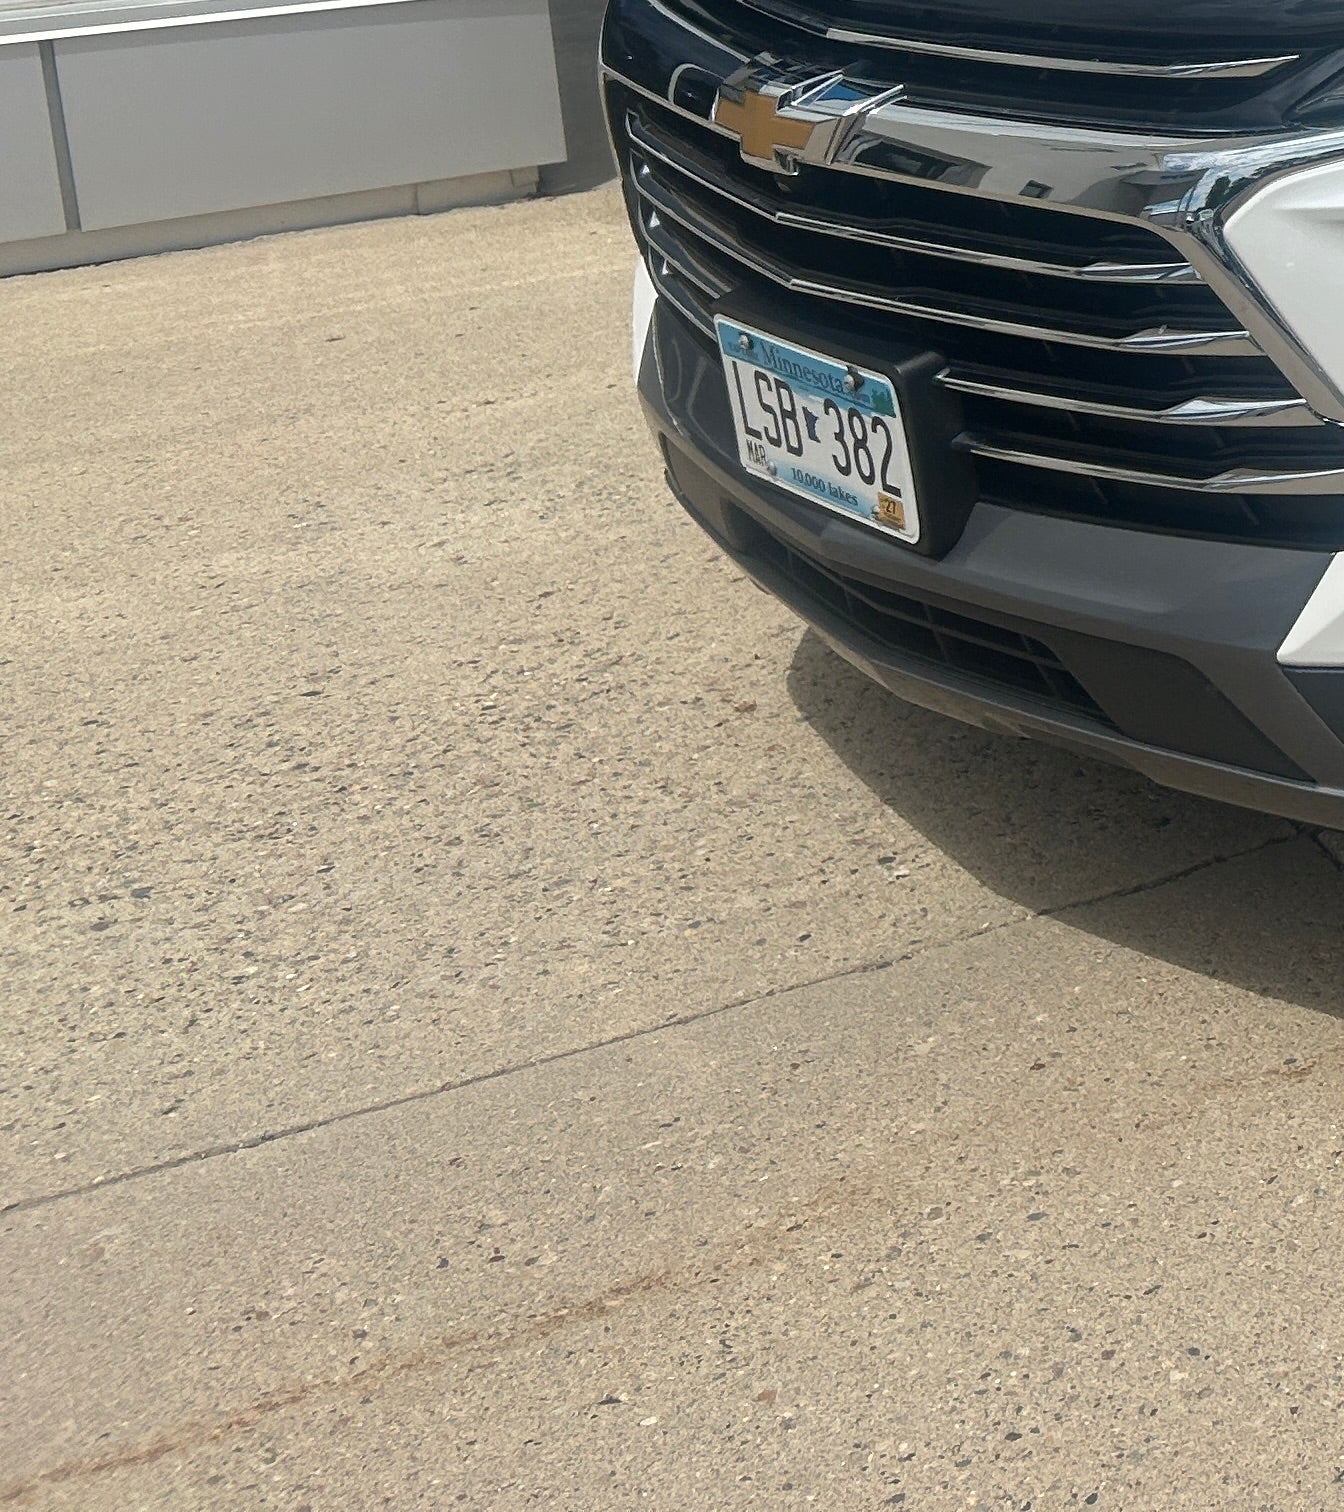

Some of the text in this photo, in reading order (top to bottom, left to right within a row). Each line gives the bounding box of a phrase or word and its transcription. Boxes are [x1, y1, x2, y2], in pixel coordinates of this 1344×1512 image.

[760, 341, 845, 396] Minnesota
[732, 360, 902, 498] LSB 382
[828, 481, 859, 507] lakes
